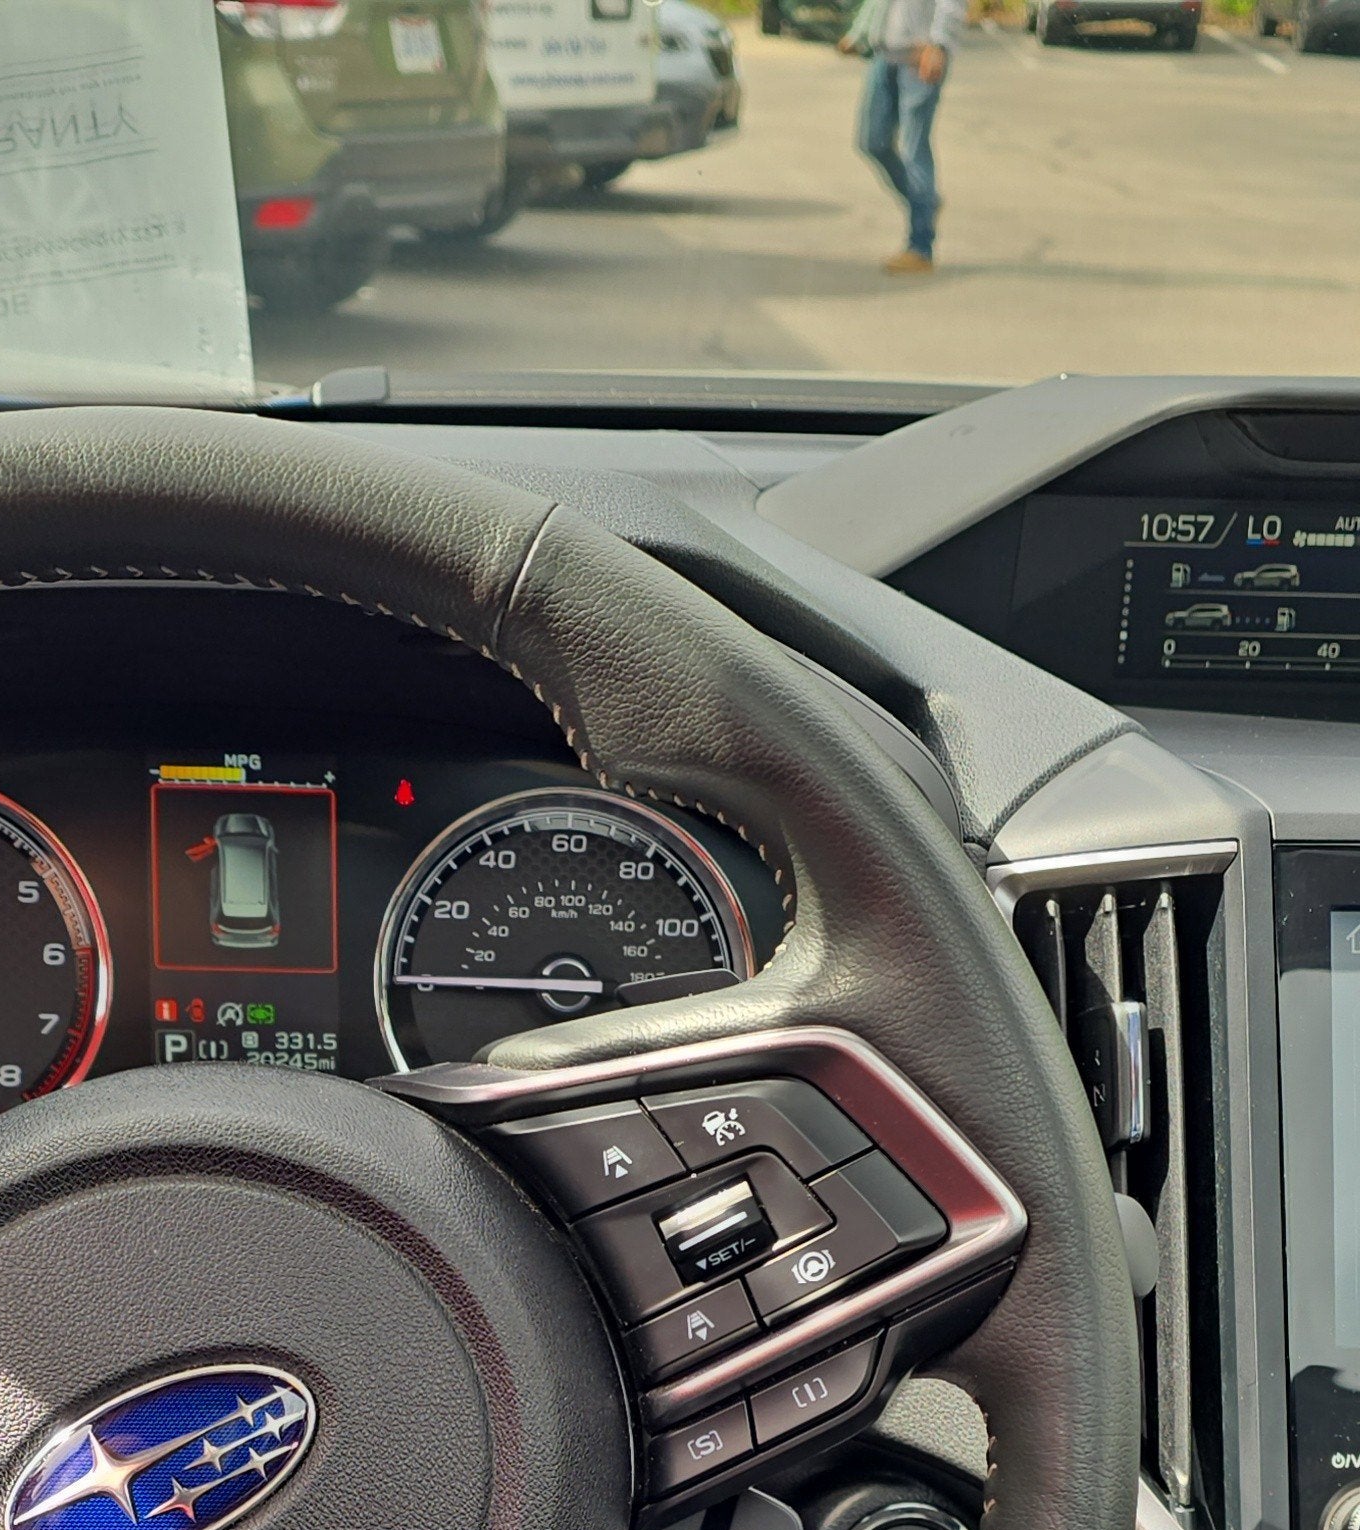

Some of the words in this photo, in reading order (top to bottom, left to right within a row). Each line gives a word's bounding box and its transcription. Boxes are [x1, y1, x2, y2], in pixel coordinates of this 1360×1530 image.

[1140, 513, 1214, 542] 10:57
[1247, 515, 1282, 541] LO
[1163, 638, 1176, 656] 0
[1239, 640, 1261, 657] 20
[1317, 643, 1340, 658] 40
[223, 753, 262, 771] MPG
[551, 834, 588, 853] 60
[478, 850, 516, 869] 40
[619, 861, 654, 881] 80
[17, 880, 40, 904] 5
[560, 895, 586, 907] 100
[433, 900, 470, 920] 20
[534, 896, 555, 908] 80
[588, 903, 613, 916] 120
[508, 907, 530, 919] 60
[550, 907, 578, 920] km/h
[487, 925, 510, 938] 40
[610, 920, 636, 933] 140
[655, 918, 699, 937] 100
[42, 943, 66, 966] 6
[473, 950, 496, 962] 20
[622, 945, 648, 958] 160
[38, 1013, 60, 1034] 7
[164, 1033, 188, 1063] P
[274, 1031, 338, 1051] 331.5
